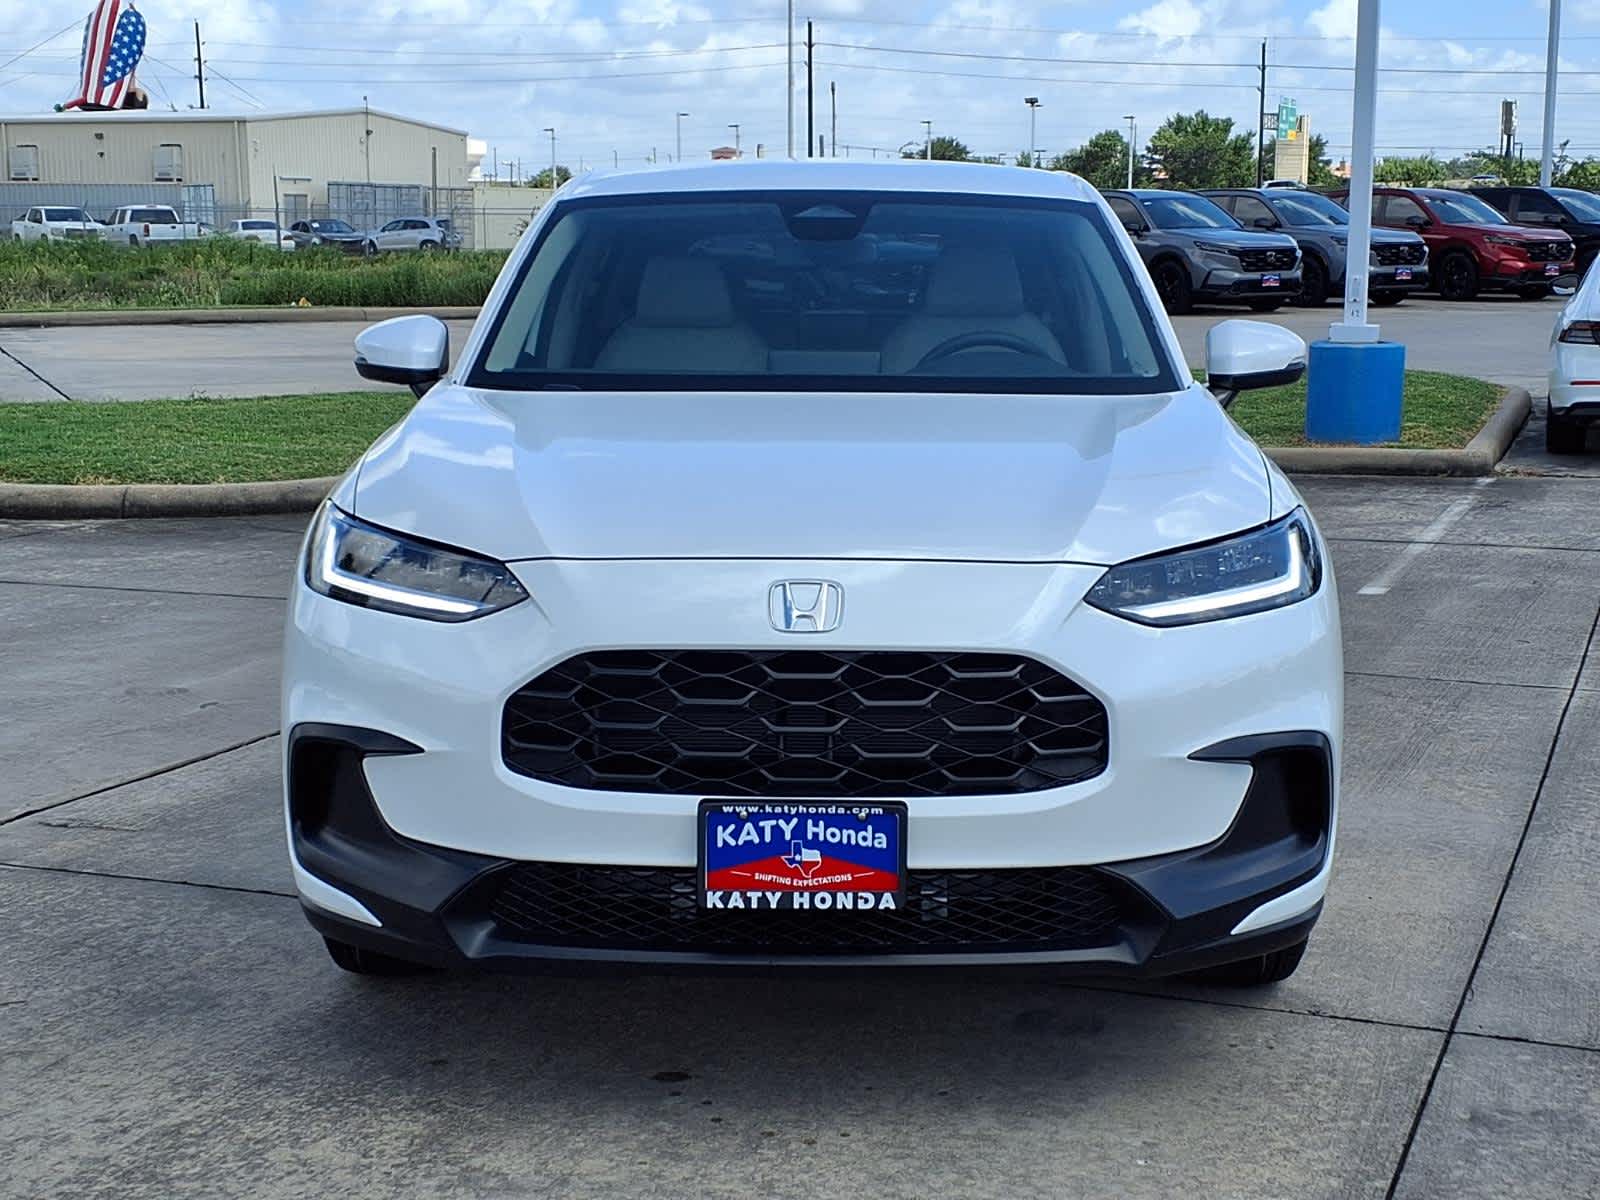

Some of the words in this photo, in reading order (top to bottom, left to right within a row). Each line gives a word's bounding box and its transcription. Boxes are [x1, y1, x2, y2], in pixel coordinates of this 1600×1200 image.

[722, 804, 884, 815] www.katyhonda.com
[717, 817, 799, 848] KATY
[807, 819, 887, 849] Honda
[754, 872, 791, 886] SHIFTING
[793, 873, 853, 887] EXPECTATIONS
[706, 891, 783, 909] KATY
[793, 891, 896, 910] HONDA
